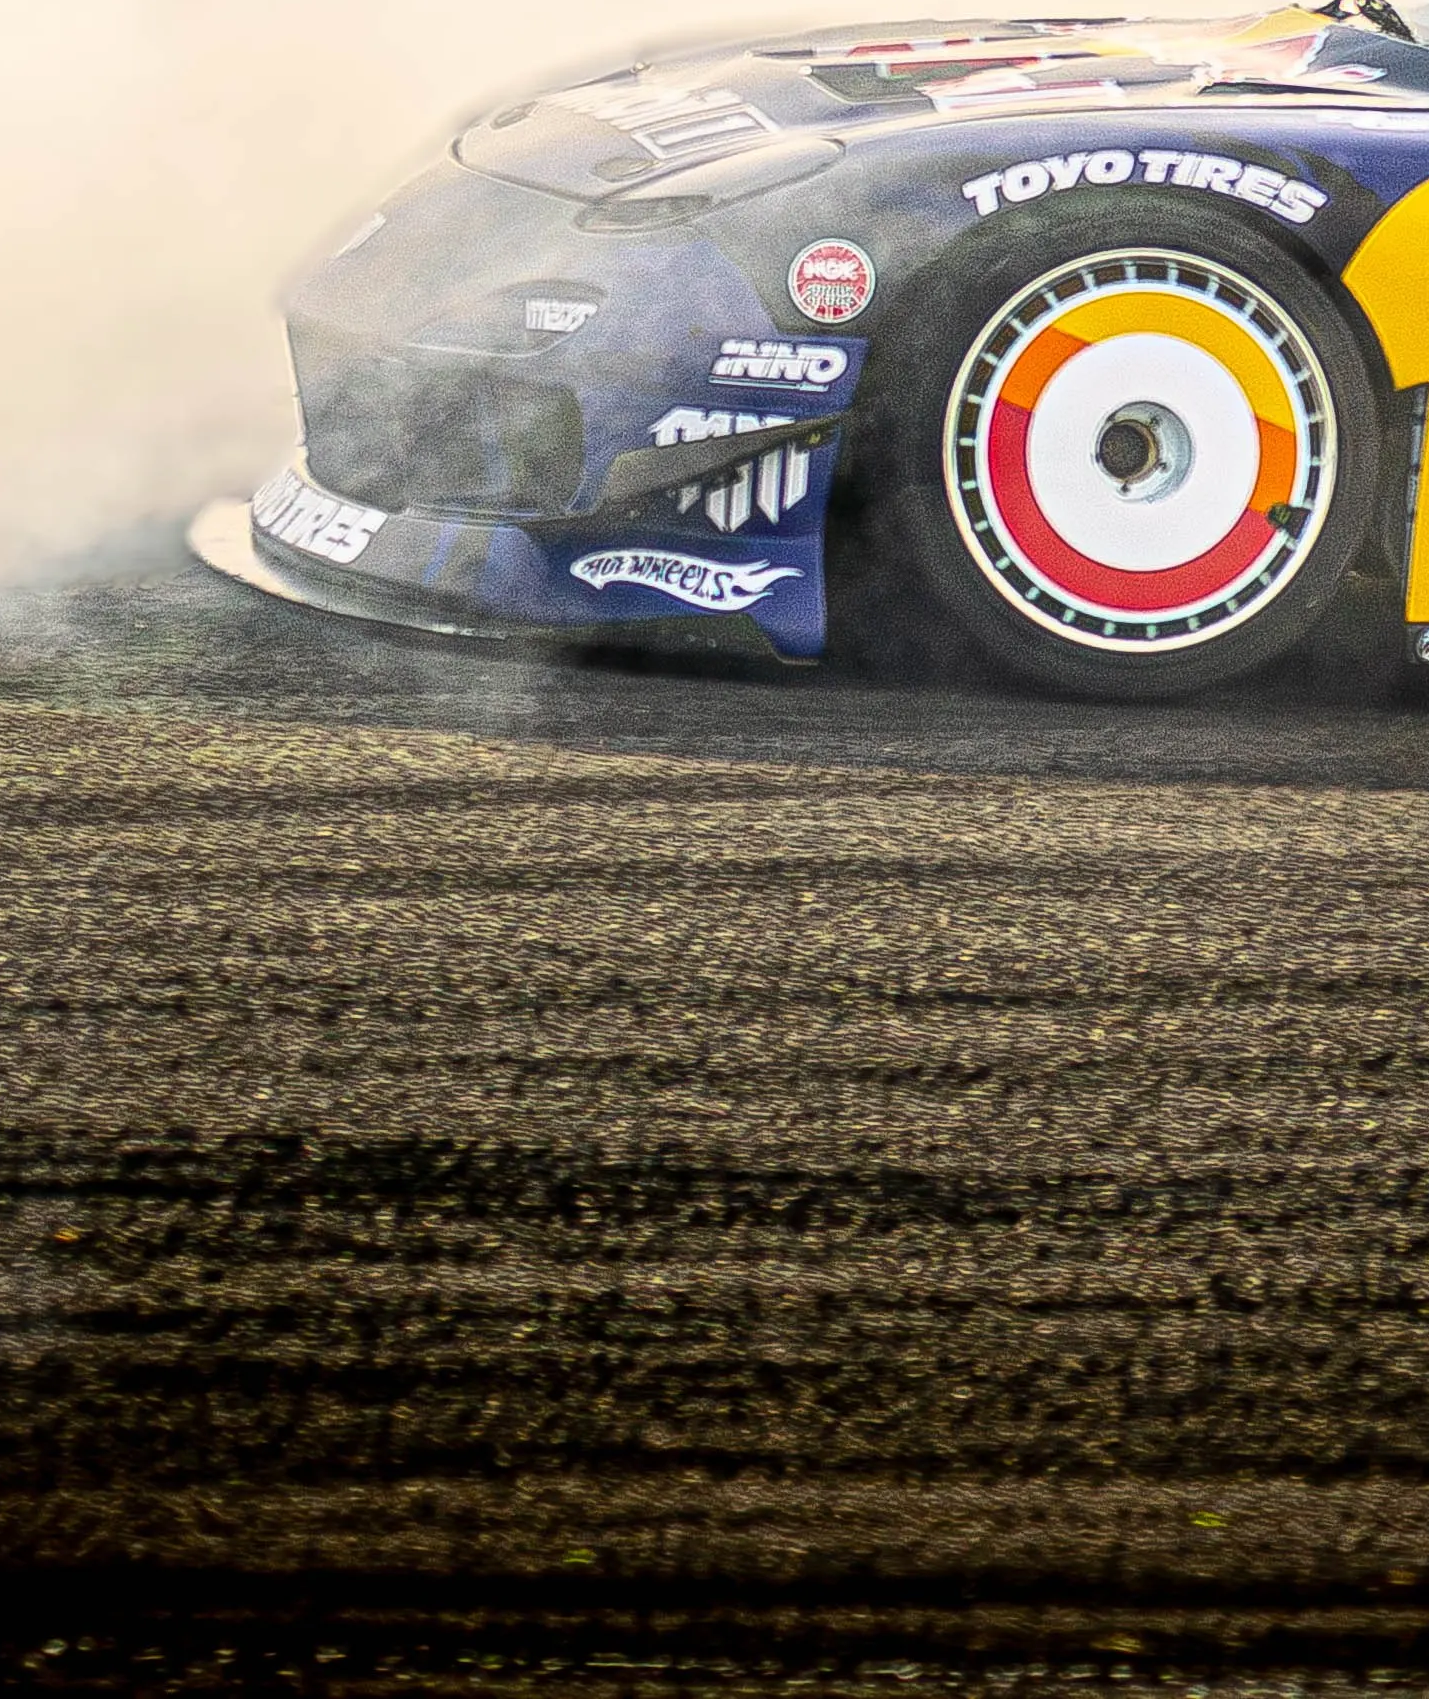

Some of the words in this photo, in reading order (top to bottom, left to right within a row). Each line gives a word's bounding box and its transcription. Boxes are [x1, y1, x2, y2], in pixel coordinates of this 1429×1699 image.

[962, 149, 1134, 216] TOYO
[1138, 149, 1329, 224] TIRES
[803, 258, 861, 281] NGK
